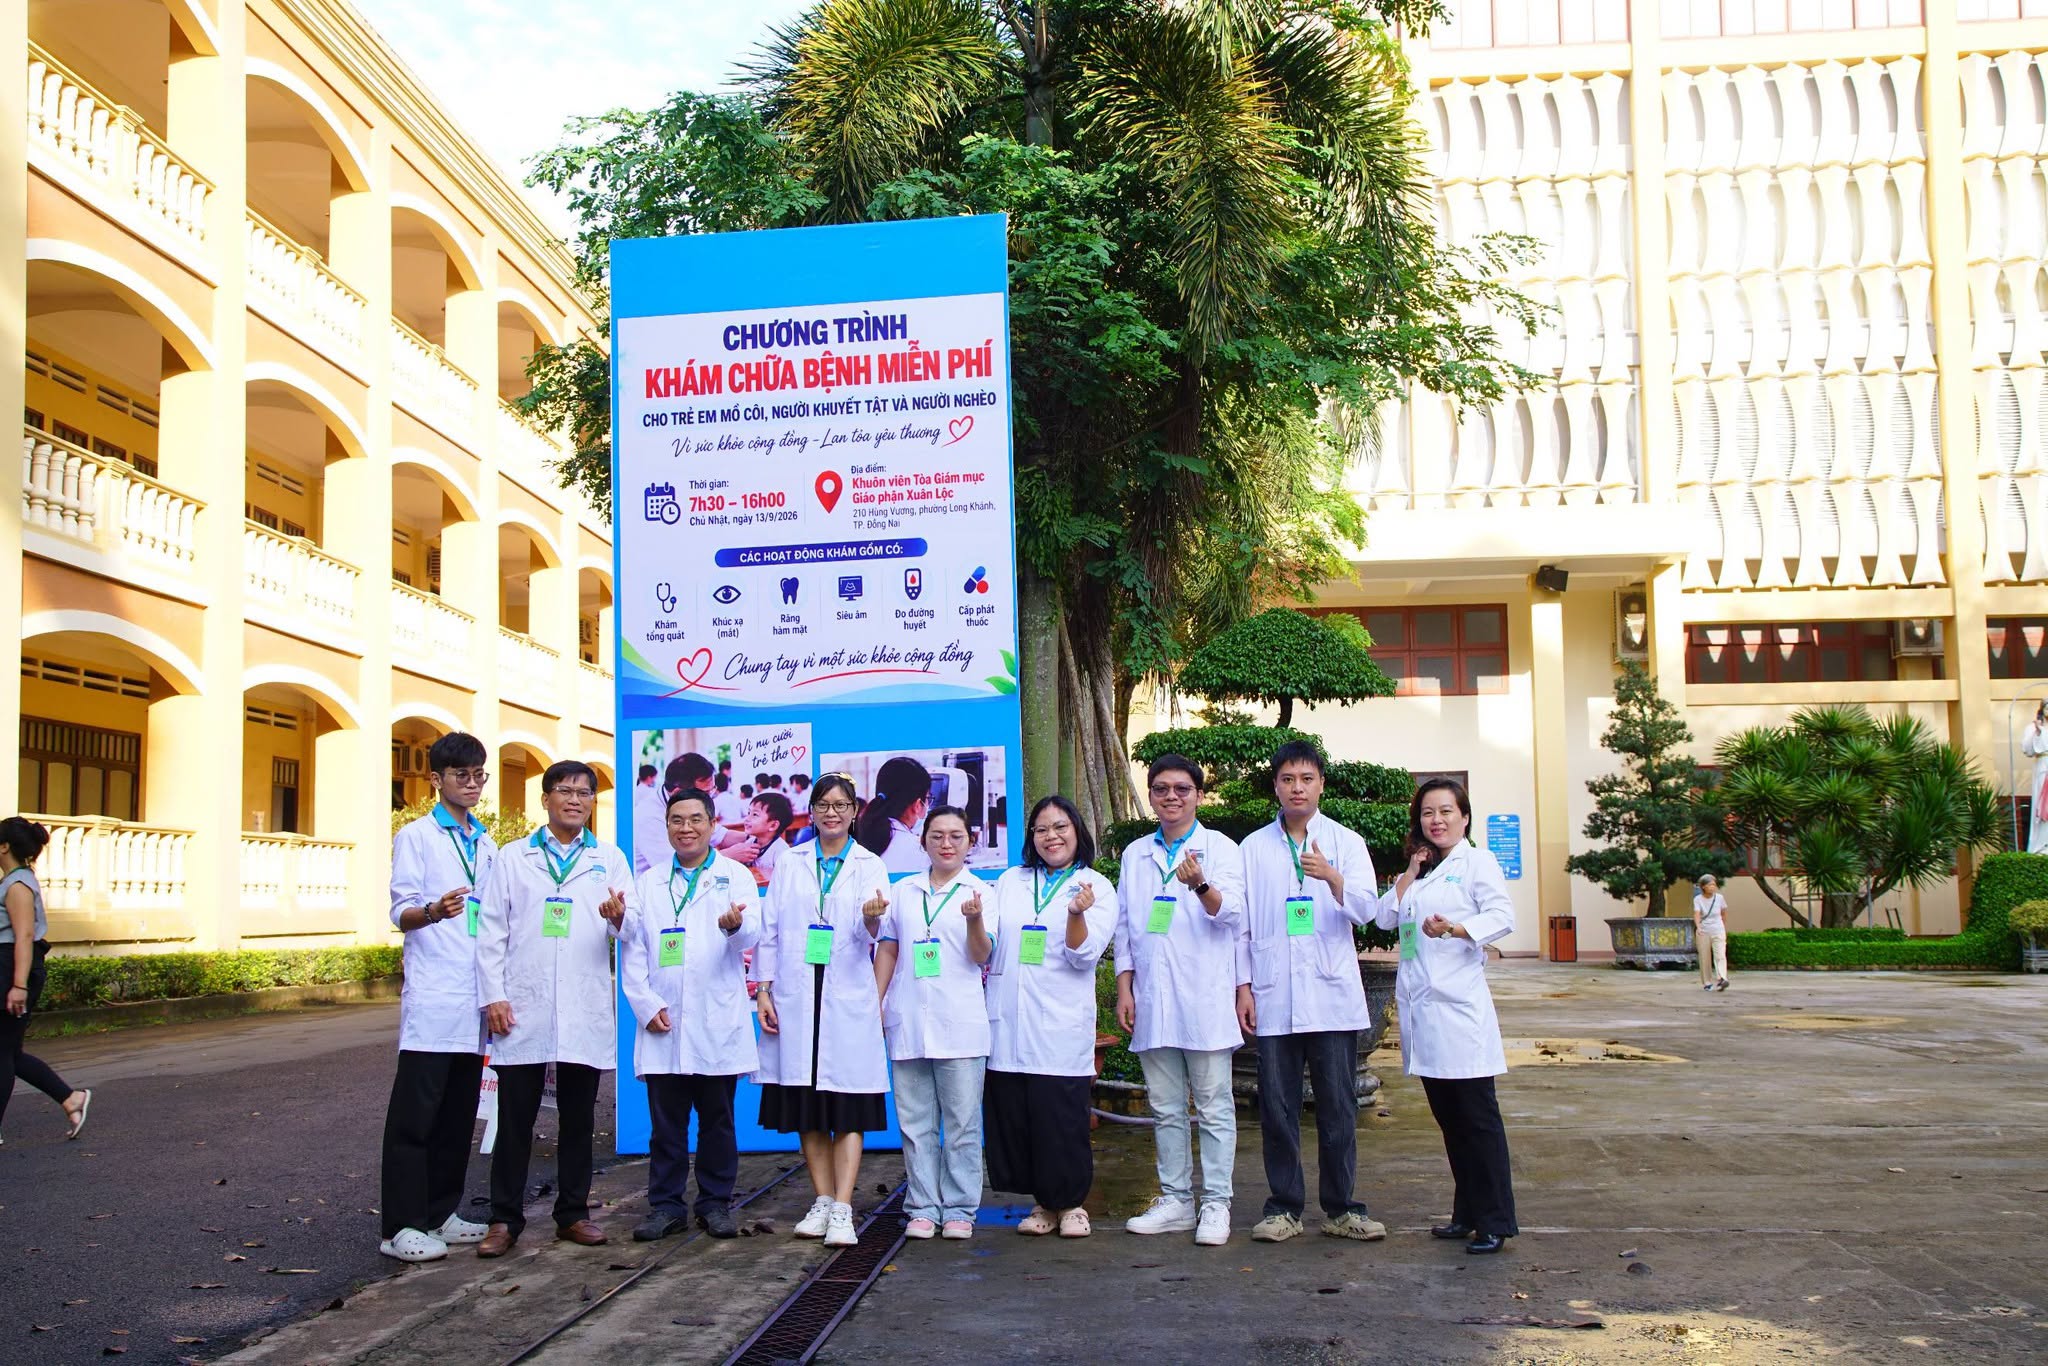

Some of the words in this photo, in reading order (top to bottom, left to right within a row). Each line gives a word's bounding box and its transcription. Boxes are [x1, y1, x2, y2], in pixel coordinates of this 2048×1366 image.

[723, 319, 828, 351] CHƯƠNG
[833, 310, 907, 343] TRÌNH
[645, 359, 722, 399] KHÁM
[728, 354, 798, 393] CHỮA
[803, 350, 872, 394] BỆNH
[878, 339, 940, 384] MIỄN
[948, 339, 993, 379] PHÍ
[643, 414, 668, 427] CHO
[671, 407, 694, 425] TRẺ
[698, 409, 717, 423] EM
[720, 403, 740, 422] MỒ
[744, 404, 768, 422] CÔI,
[772, 401, 810, 419] NGƯỜI
[813, 396, 862, 417] KHUYẾT
[865, 396, 888, 416] TẬT
[892, 394, 909, 412] VÀ
[912, 392, 950, 410] NGƯỜI
[954, 389, 996, 407] NGHÈO
[671, 437, 691, 457] Vì
[695, 440, 714, 454] sức
[717, 434, 745, 451] khỏe
[748, 436, 775, 455] cộng
[779, 430, 808, 453] đồng
[820, 428, 848, 448] Lan
[852, 428, 872, 442] tỏa
[874, 429, 896, 448] yêu
[900, 423, 942, 445] thương
[851, 465, 863, 475] Địa
[866, 462, 887, 473] điểm:
[689, 480, 707, 489] Thời
[709, 479, 729, 490] gian:
[852, 476, 885, 489] Khuôn
[888, 475, 911, 486] viên
[913, 474, 931, 485] Tòa
[934, 472, 960, 484] Giám
[963, 471, 985, 485] mục
[689, 495, 725, 512] 7h30
[741, 491, 785, 509] 16h00
[852, 491, 875, 504] Giáo
[878, 490, 904, 505] phận
[906, 489, 933, 501] Xuân
[936, 487, 954, 501] Lộc
[853, 509, 866, 517] 210
[868, 508, 888, 519] Hùng
[890, 506, 917, 516] Vương,
[919, 504, 947, 516] phường
[950, 504, 968, 514] Long
[969, 501, 996, 511] Khánh,
[690, 516, 705, 526] Chủ
[708, 515, 730, 527] Nhật,
[733, 513, 752, 525] ngày
[756, 511, 798, 524] 13/9/2026
[853, 520, 865, 529] TP.
[867, 519, 887, 530] Đồng
[888, 519, 901, 527] Nai
[740, 552, 761, 563] CÁC
[763, 551, 792, 563] HOẠT
[794, 548, 824, 562] ĐỘNG
[827, 545, 857, 558] KHÁM
[859, 542, 883, 556] GỒM
[885, 542, 903, 555] CÓ:
[837, 610, 854, 620] Siêu
[855, 611, 867, 619] âm
[895, 609, 906, 618] Đo
[909, 608, 934, 618] đường
[958, 604, 974, 617] Cấp
[976, 604, 995, 616] phát
[655, 620, 677, 630] Khám
[712, 617, 733, 627] Khúc
[735, 619, 744, 627] xạ
[780, 614, 801, 624] Răng
[904, 619, 926, 631] huyết
[966, 616, 989, 627] thuốc
[646, 630, 665, 642] tổng
[667, 631, 685, 642] quát
[717, 628, 739, 640] (mắt)
[773, 625, 790, 635] hàm
[792, 625, 807, 636] mặt
[724, 652, 773, 683] Chung
[776, 654, 800, 681] tay
[803, 652, 816, 668] vì
[819, 649, 845, 669] một
[847, 649, 868, 667] sức
[870, 645, 901, 664] khỏe
[904, 648, 935, 672] cộng
[939, 639, 974, 672] đồng
[736, 738, 752, 757] Vì
[756, 740, 769, 749] nụ
[773, 728, 793, 743] cười
[752, 754, 768, 768] trẻ
[771, 745, 788, 762] thơ
